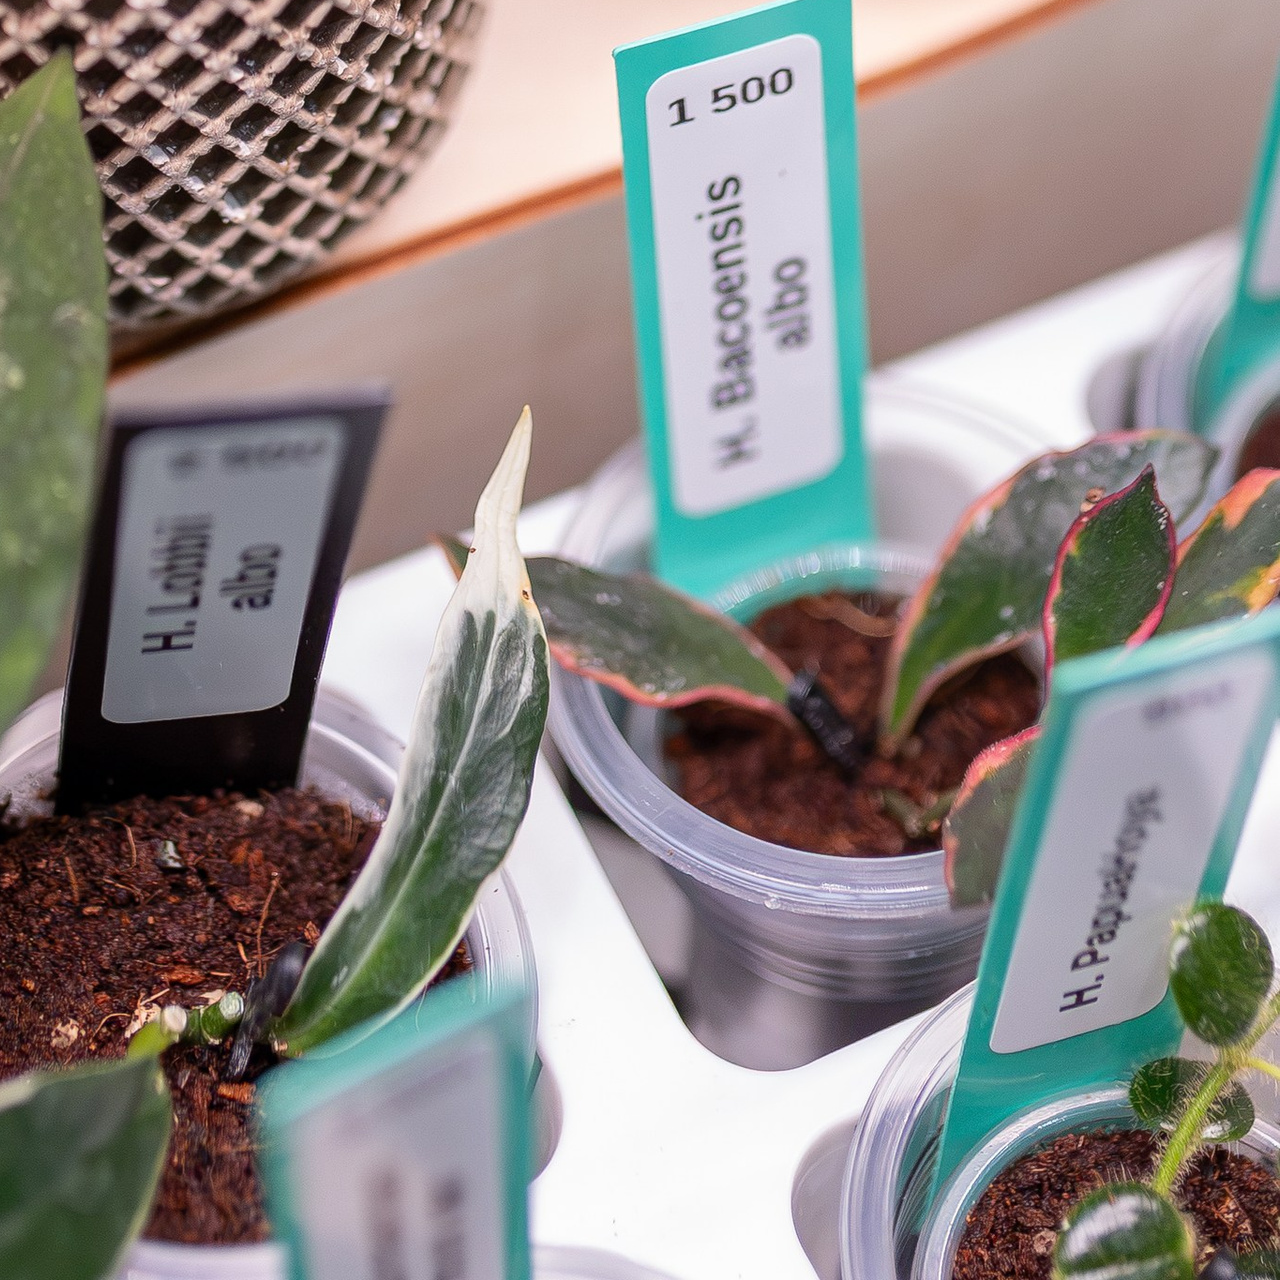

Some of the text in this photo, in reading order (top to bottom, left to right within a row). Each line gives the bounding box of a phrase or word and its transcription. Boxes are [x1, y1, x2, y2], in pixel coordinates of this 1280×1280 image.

[668, 66, 795, 127] 1 500
[695, 174, 756, 414] Bacoensis
[763, 254, 812, 352] albo
[219, 544, 283, 612] albo
[140, 619, 197, 655] H.
[1058, 973, 1105, 1013] H.
